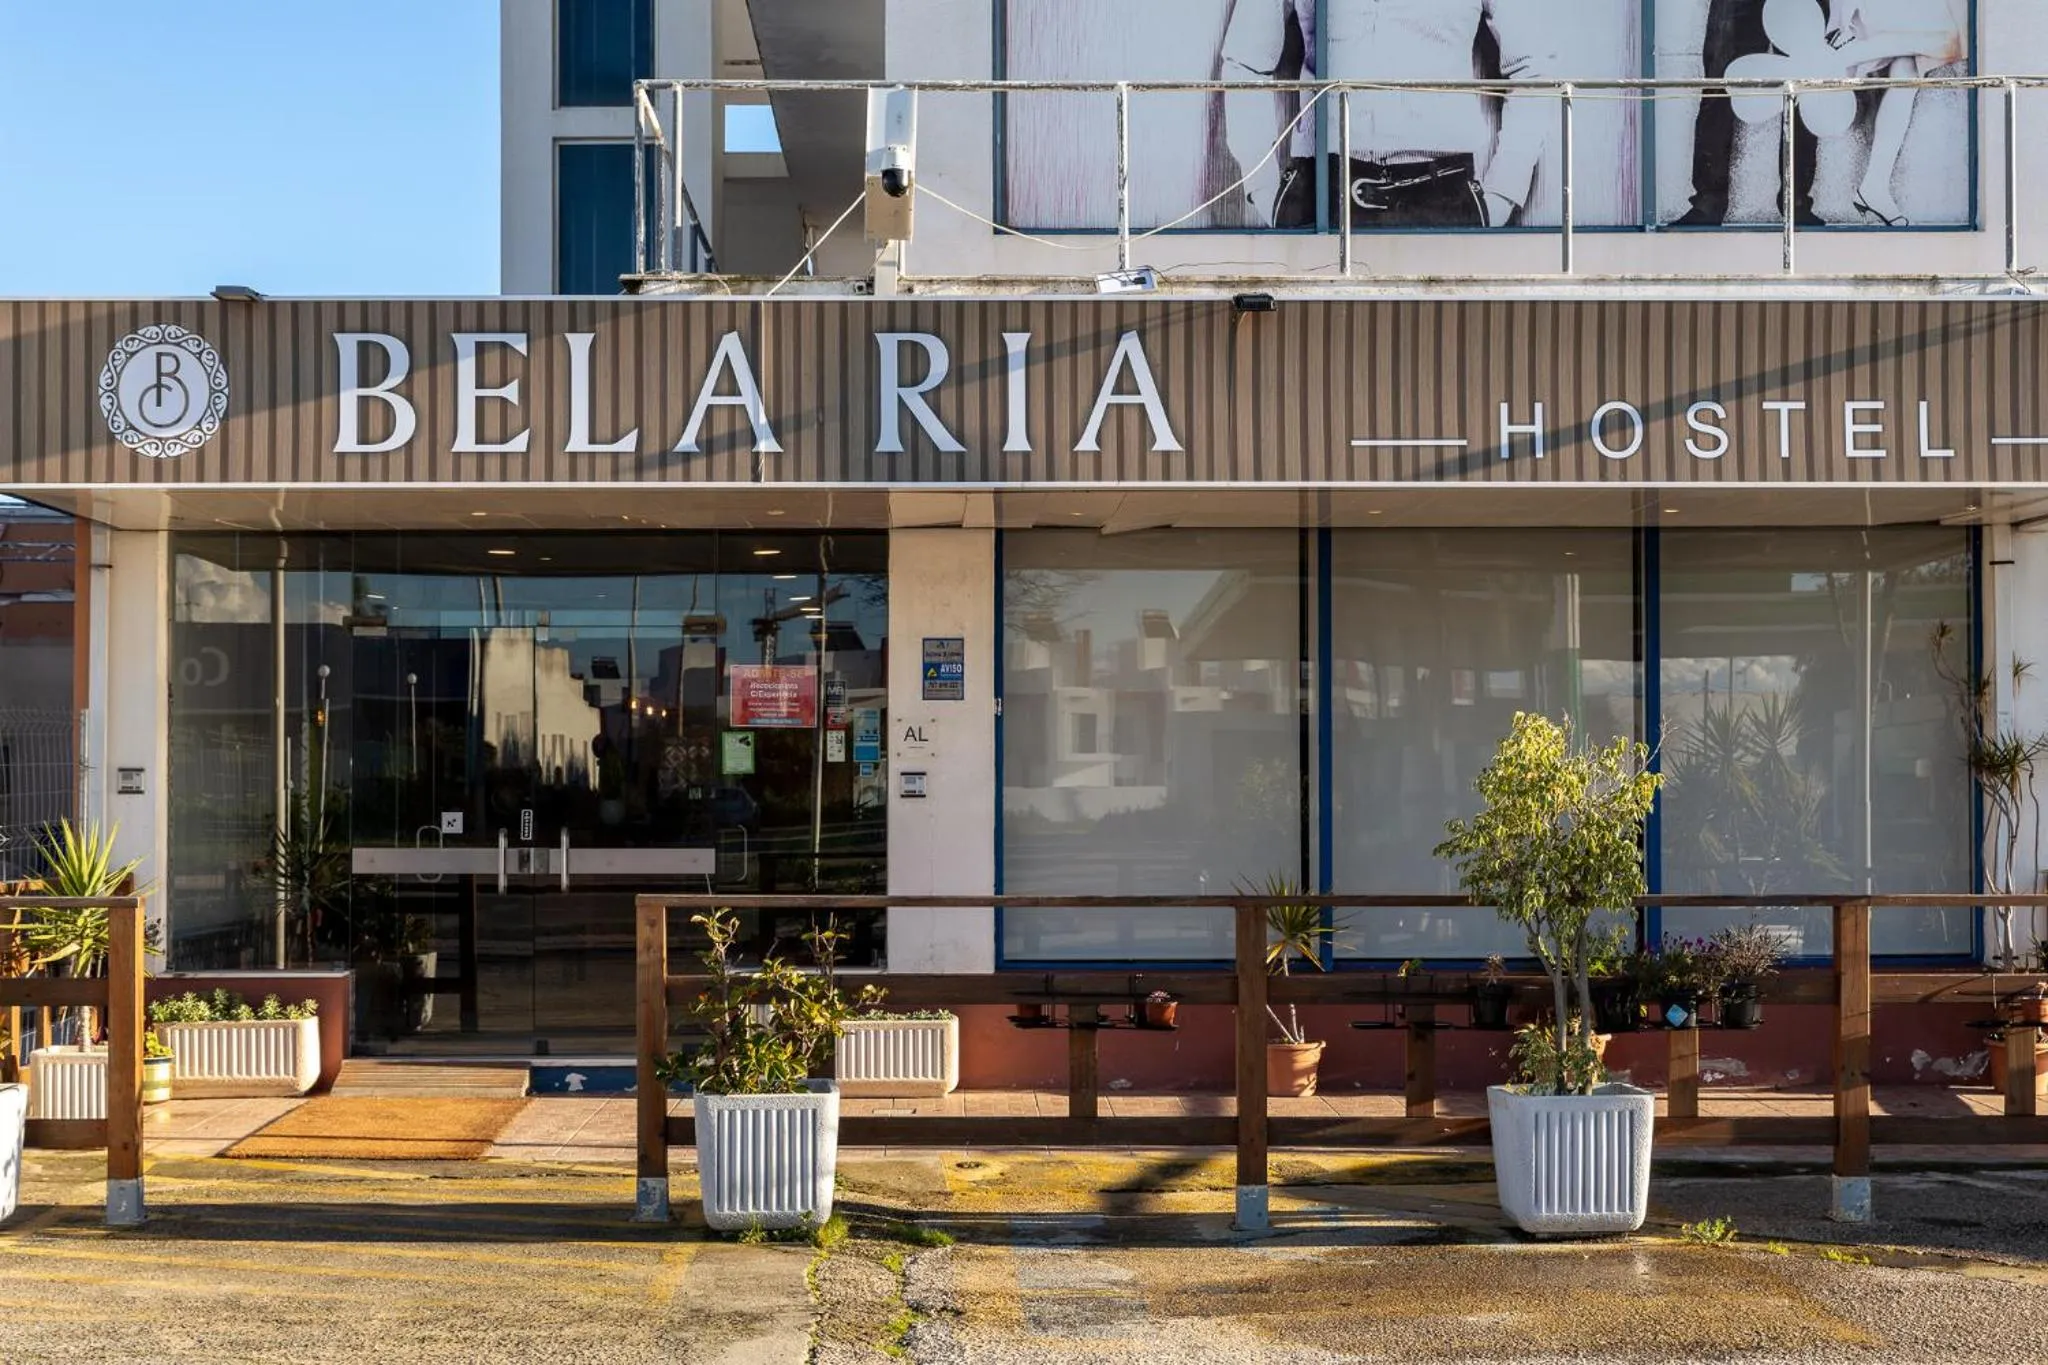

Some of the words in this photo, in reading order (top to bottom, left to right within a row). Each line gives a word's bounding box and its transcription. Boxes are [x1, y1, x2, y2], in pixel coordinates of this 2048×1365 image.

[1499, 400, 1955, 460] HOSTEL
[941, 664, 962, 673] AVISO
[903, 726, 929, 742] AL
